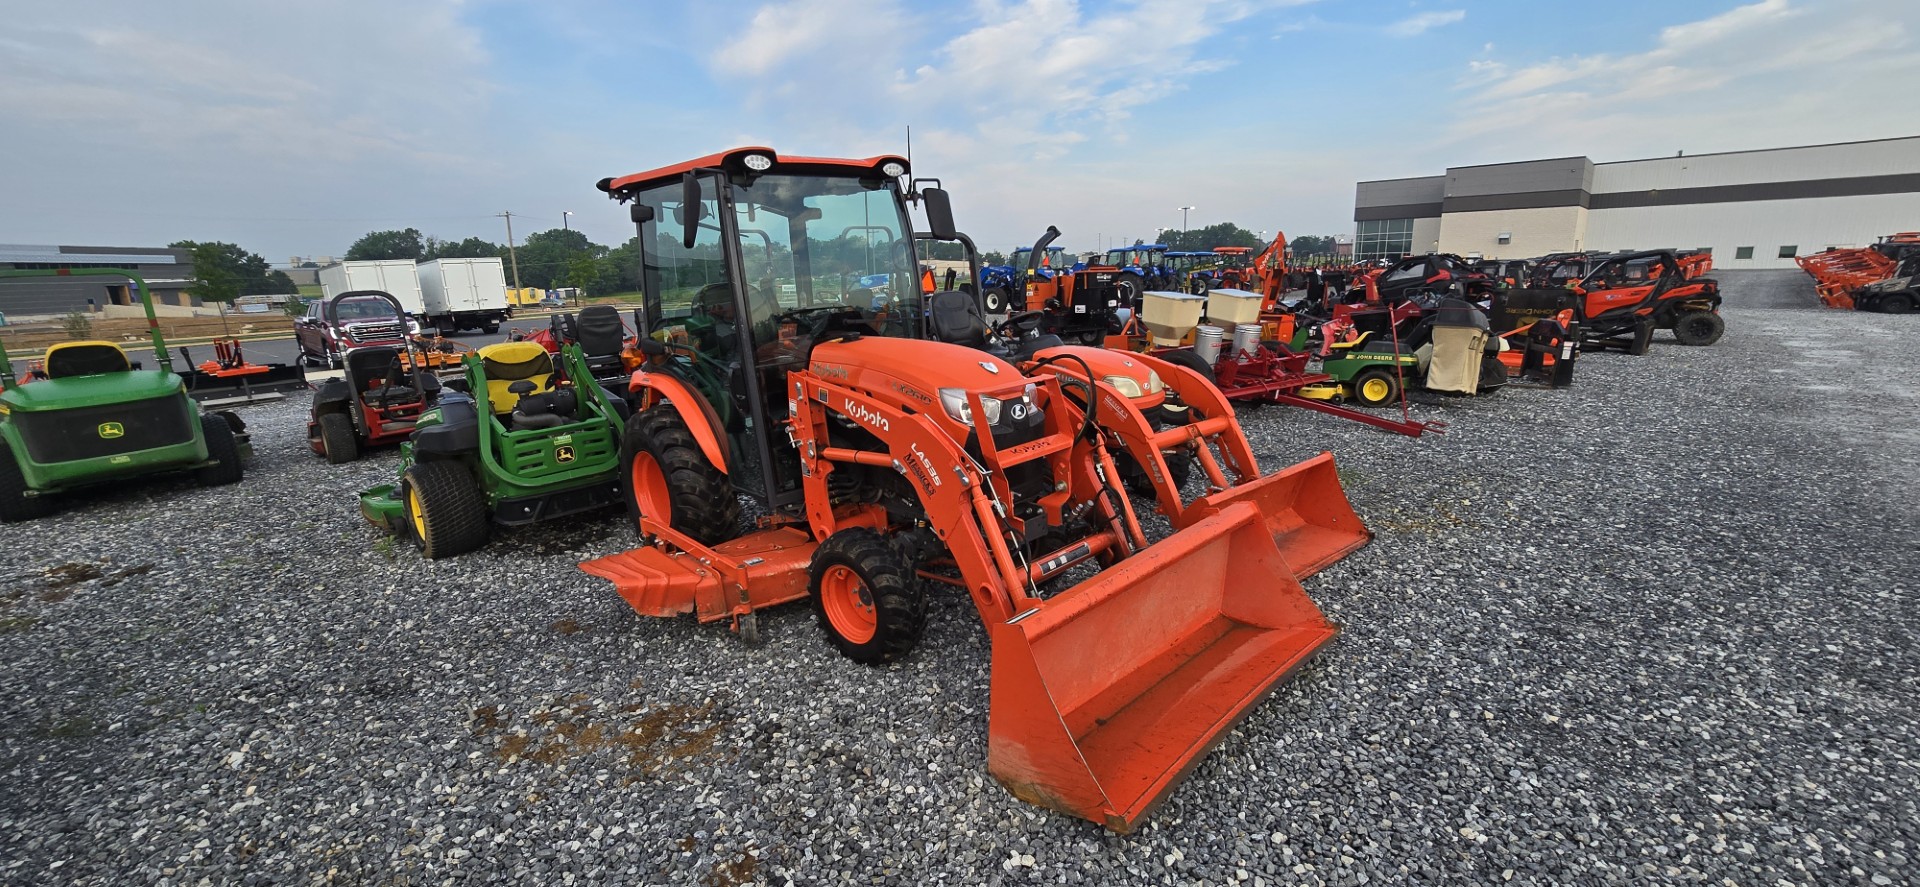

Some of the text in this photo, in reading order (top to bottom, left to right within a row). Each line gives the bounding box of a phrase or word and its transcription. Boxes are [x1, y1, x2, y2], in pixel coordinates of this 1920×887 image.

[813, 361, 849, 380] Kubota
[844, 397, 890, 432] Kubota
[1009, 440, 1052, 455] Kubota
[911, 442, 943, 487] LA535
